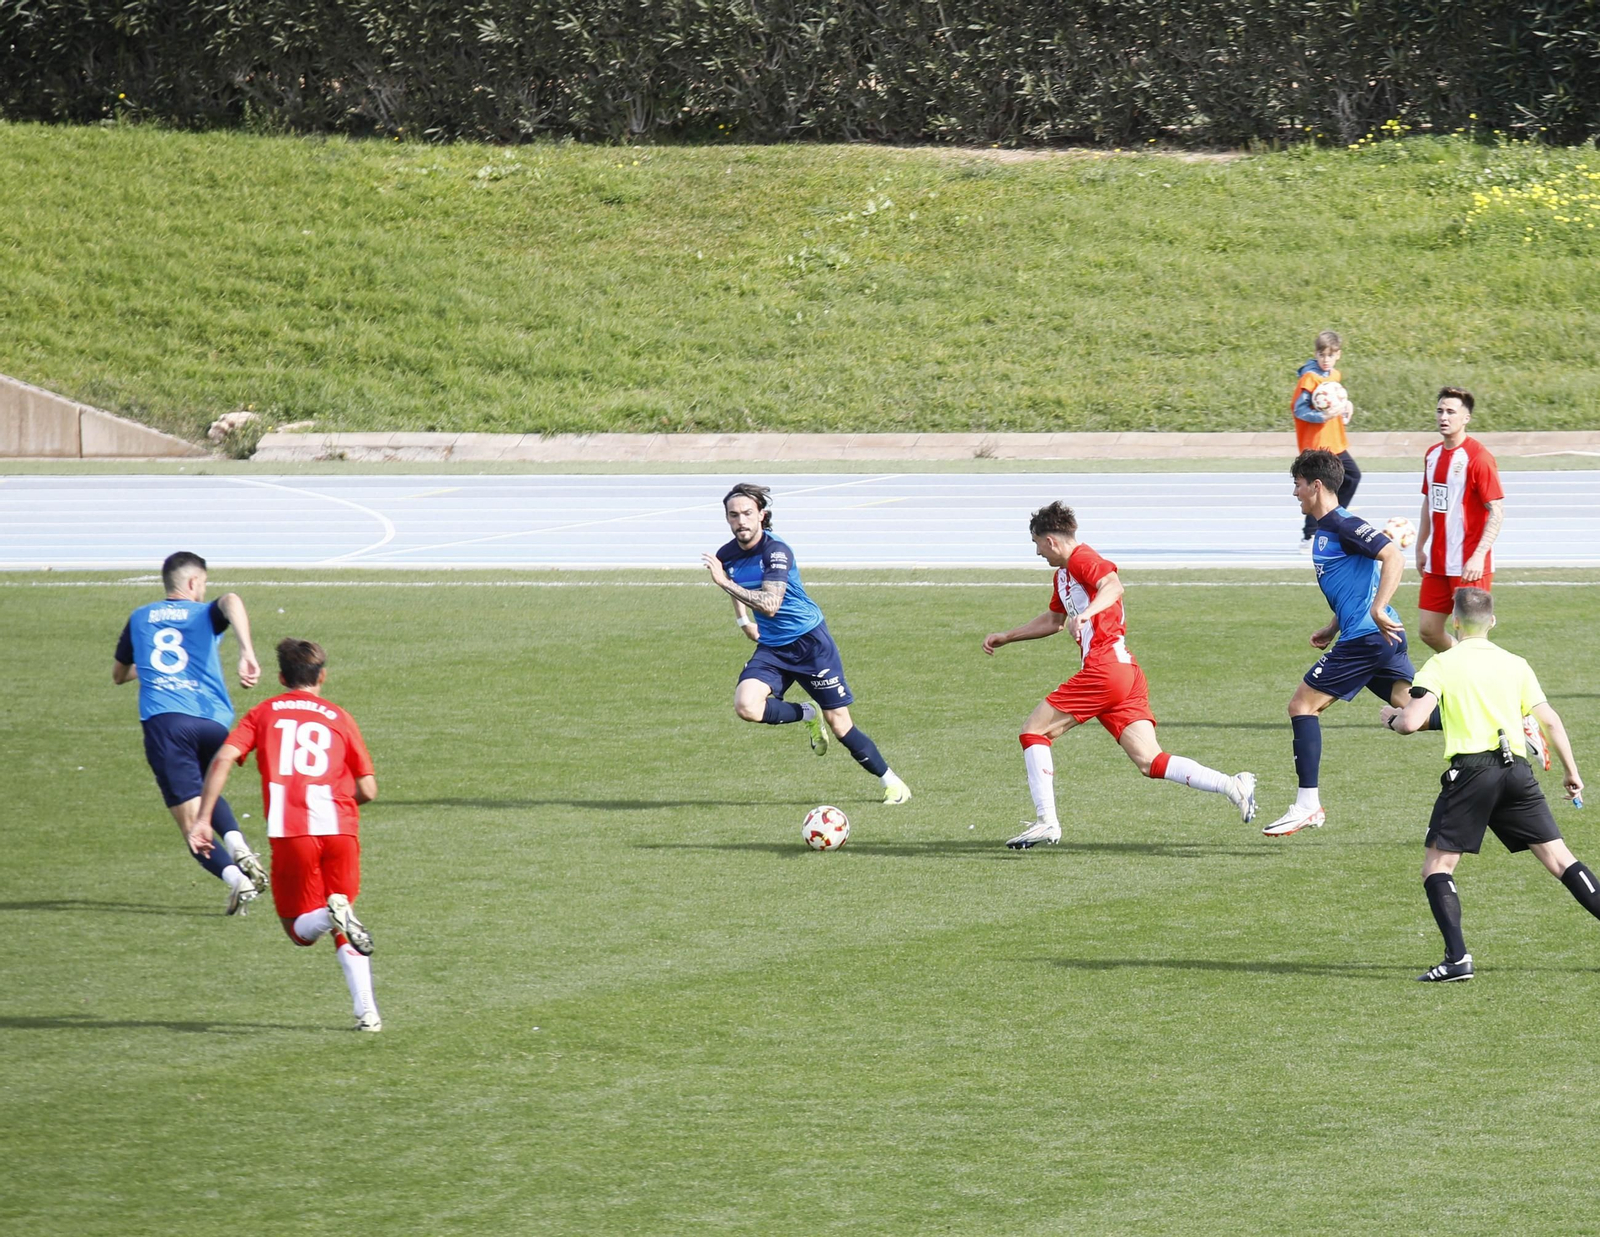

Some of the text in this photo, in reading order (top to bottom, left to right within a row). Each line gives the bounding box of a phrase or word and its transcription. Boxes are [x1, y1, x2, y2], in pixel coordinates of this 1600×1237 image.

[150, 627, 189, 674] 8
[272, 700, 338, 721] MORILLO
[274, 719, 332, 777] 18
